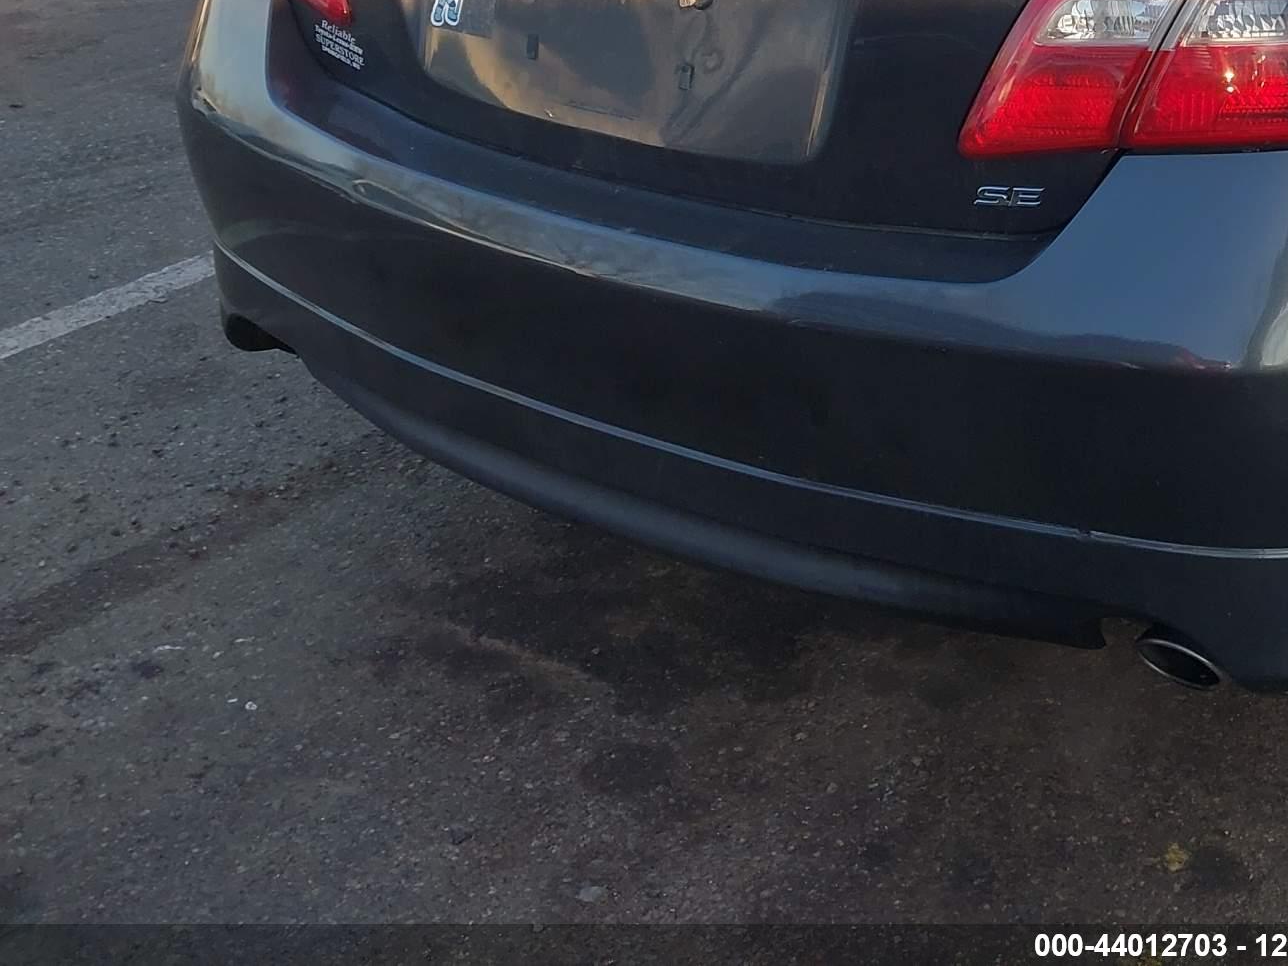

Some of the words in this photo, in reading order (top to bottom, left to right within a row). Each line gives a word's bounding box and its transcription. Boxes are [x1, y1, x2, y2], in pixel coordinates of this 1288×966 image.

[321, 19, 356, 44] Reliable
[315, 33, 365, 66] SUPERSTORE
[973, 186, 1046, 207] SE
